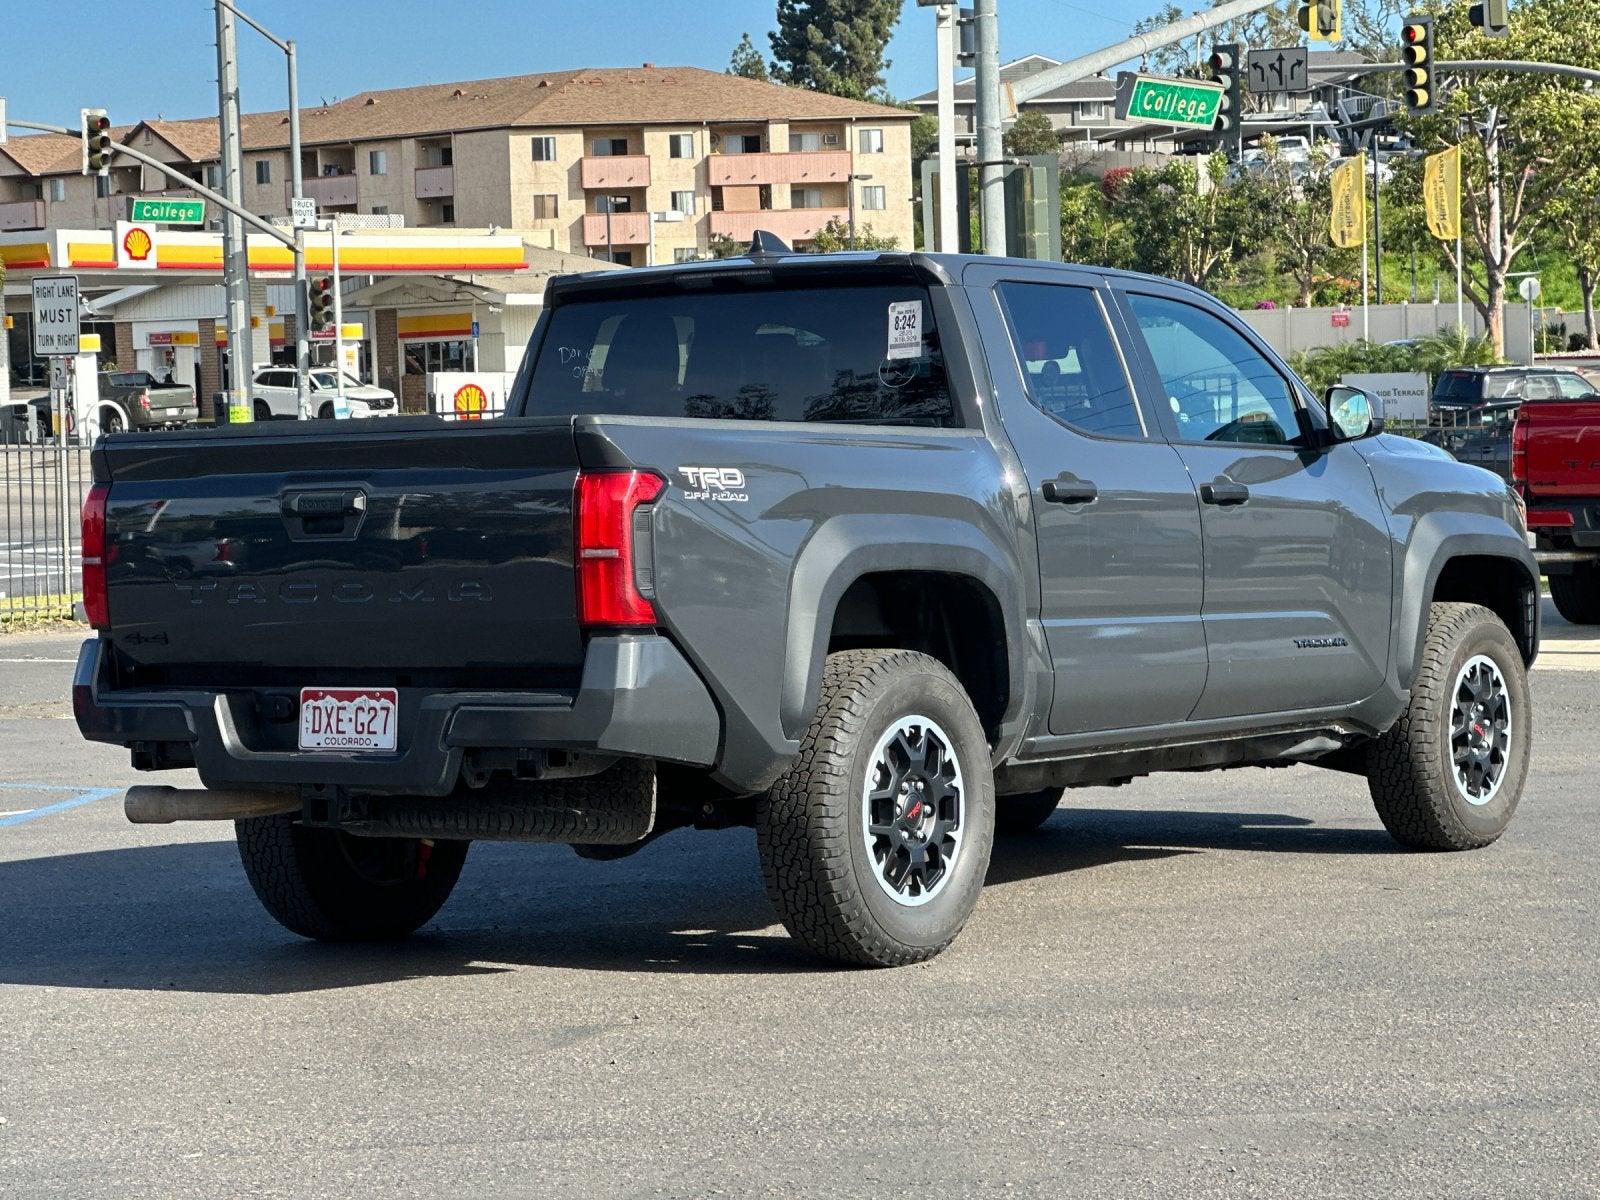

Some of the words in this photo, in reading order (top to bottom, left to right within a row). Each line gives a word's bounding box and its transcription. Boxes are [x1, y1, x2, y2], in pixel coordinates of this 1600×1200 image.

[1143, 89, 1207, 121] College
[294, 200, 314, 208] TRUCK
[143, 205, 194, 221] College
[294, 209, 314, 217] ROUTE
[36, 286, 55, 298] RIGHT
[57, 285, 75, 298] LANE
[40, 309, 72, 323] MUST
[894, 314, 916, 331] 8:242
[38, 334, 55, 347] TURN
[57, 334, 76, 346] RIGHT
[1392, 388, 1425, 397] TERRACE
[678, 466, 746, 492] TRD
[684, 490, 710, 500] OFF
[712, 490, 749, 502] ROAD
[175, 580, 493, 603] TACOMA
[324, 737, 372, 746] COLORADO
